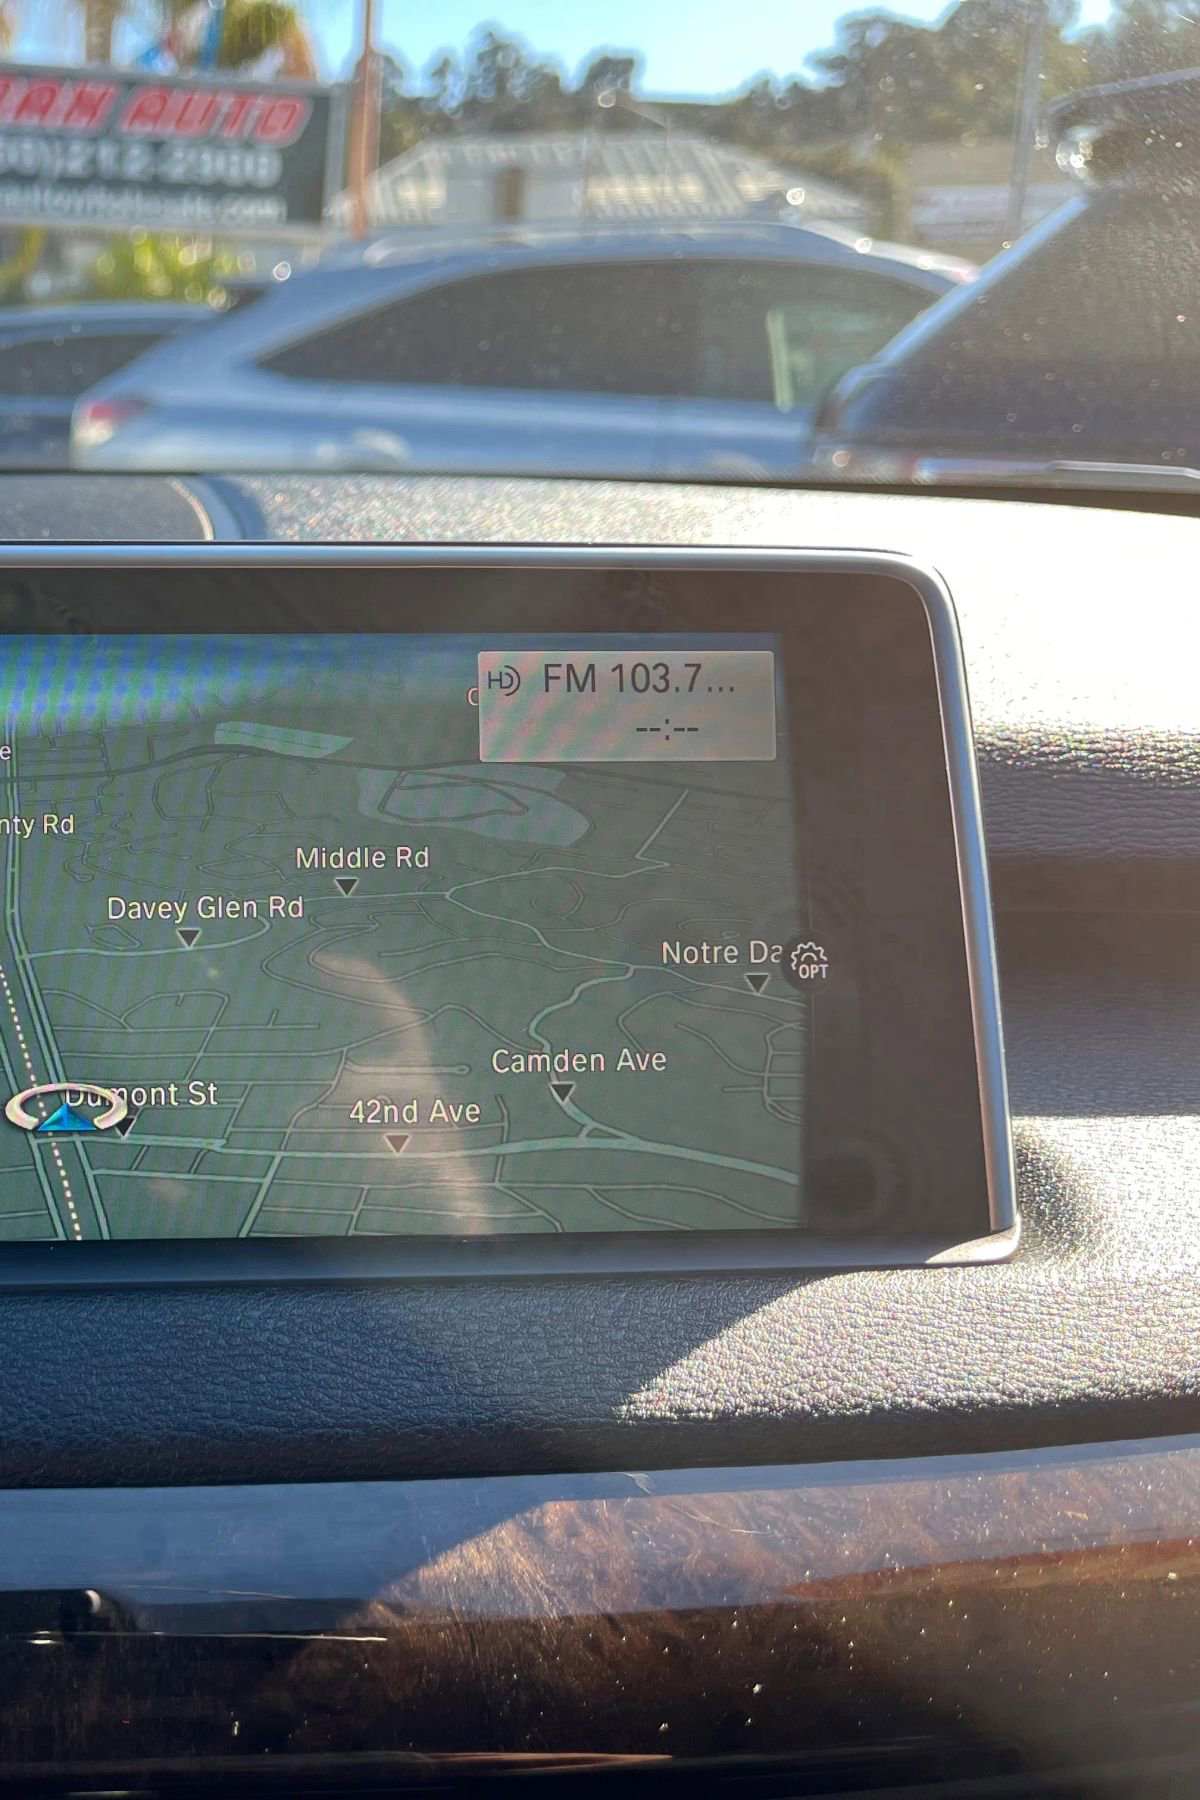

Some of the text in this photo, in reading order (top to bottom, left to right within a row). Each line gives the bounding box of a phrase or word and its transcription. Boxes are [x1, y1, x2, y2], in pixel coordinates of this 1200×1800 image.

[117, 83, 310, 144] AUTO
[544, 663, 596, 693] FM
[43, 814, 75, 835] Rd
[295, 847, 429, 869] Middle Rd
[107, 896, 304, 923] Davey Glen Rd
[662, 940, 738, 964] Notre
[798, 963, 829, 979] OPT
[492, 1049, 667, 1073] Camden Ave
[188, 1080, 218, 1106] St
[350, 1099, 481, 1124] 42nd Ave
